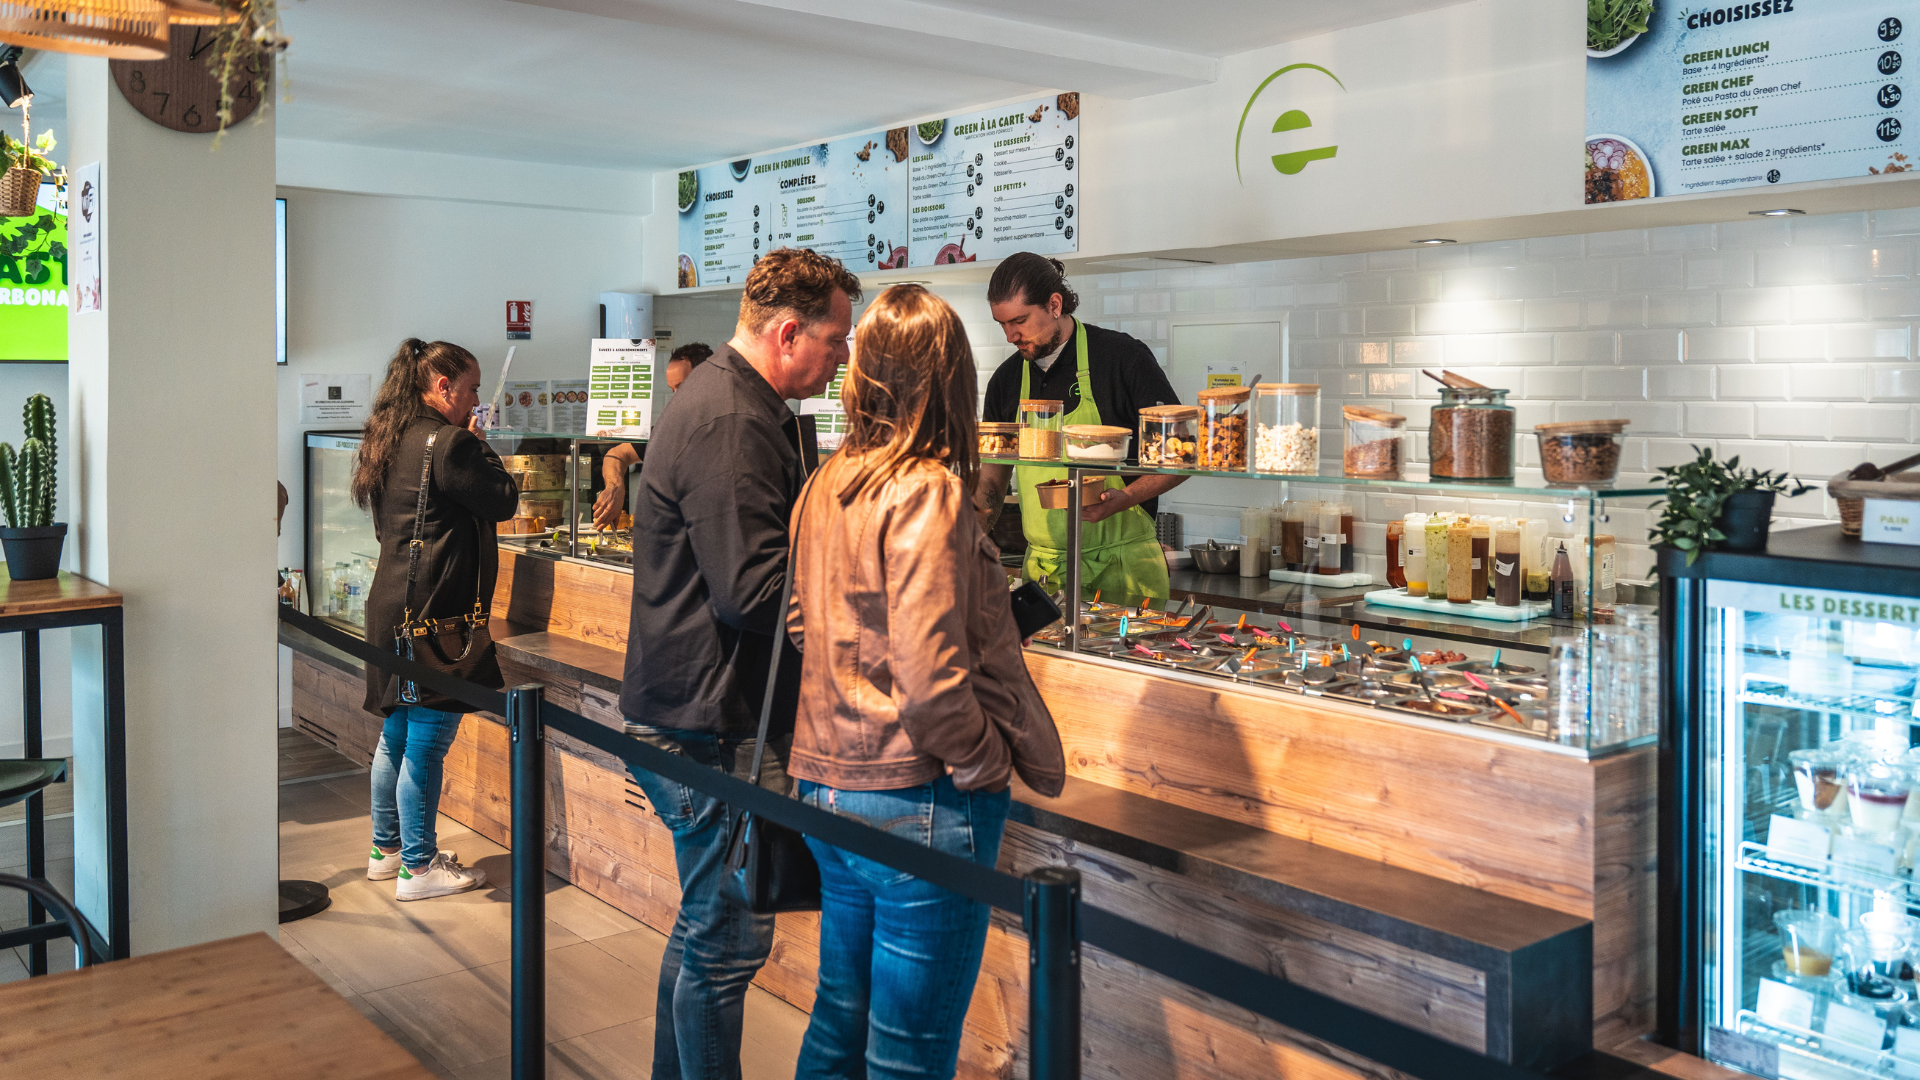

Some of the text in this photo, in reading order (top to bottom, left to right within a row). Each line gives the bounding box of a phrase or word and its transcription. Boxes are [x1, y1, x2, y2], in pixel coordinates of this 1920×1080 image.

[1687, 0, 1794, 30] CHOISISSEZ
[1683, 40, 1770, 65] GREEN LUNCH
[1682, 67, 1702, 76] Base
[129, 70, 146, 94] 8
[1682, 75, 1754, 95] GREEN CHEF
[237, 80, 255, 104] 4
[1682, 96, 1701, 106] Poké
[1715, 92, 1738, 101] Pasta
[1740, 89, 1751, 98] du
[1753, 86, 1778, 96] Green
[1780, 81, 1801, 91] Chef
[153, 91, 170, 116] 7
[183, 104, 202, 127] 6
[954, 113, 1025, 136] GREEN À LA CARTE
[1682, 105, 1759, 126] GREEN SOFT
[1682, 124, 1726, 136] Tarte salée
[1003, 135, 1031, 147] DESSERTS
[1682, 138, 1750, 156] GREEN MAX
[754, 155, 810, 174] GREEN EN FORMULES
[1681, 158, 1702, 167] Tarte
[1703, 155, 1726, 164] salée
[1735, 151, 1764, 160] salade
[1765, 149, 1771, 157] 2
[780, 173, 816, 189] COMPLÉTEZ
[1003, 182, 1022, 191] PETITS
[705, 189, 733, 202] CHOISISSEZ
[920, 203, 946, 213] BOISSONS
[1879, 515, 1909, 524] PAIN
[1780, 592, 1815, 611] LES
